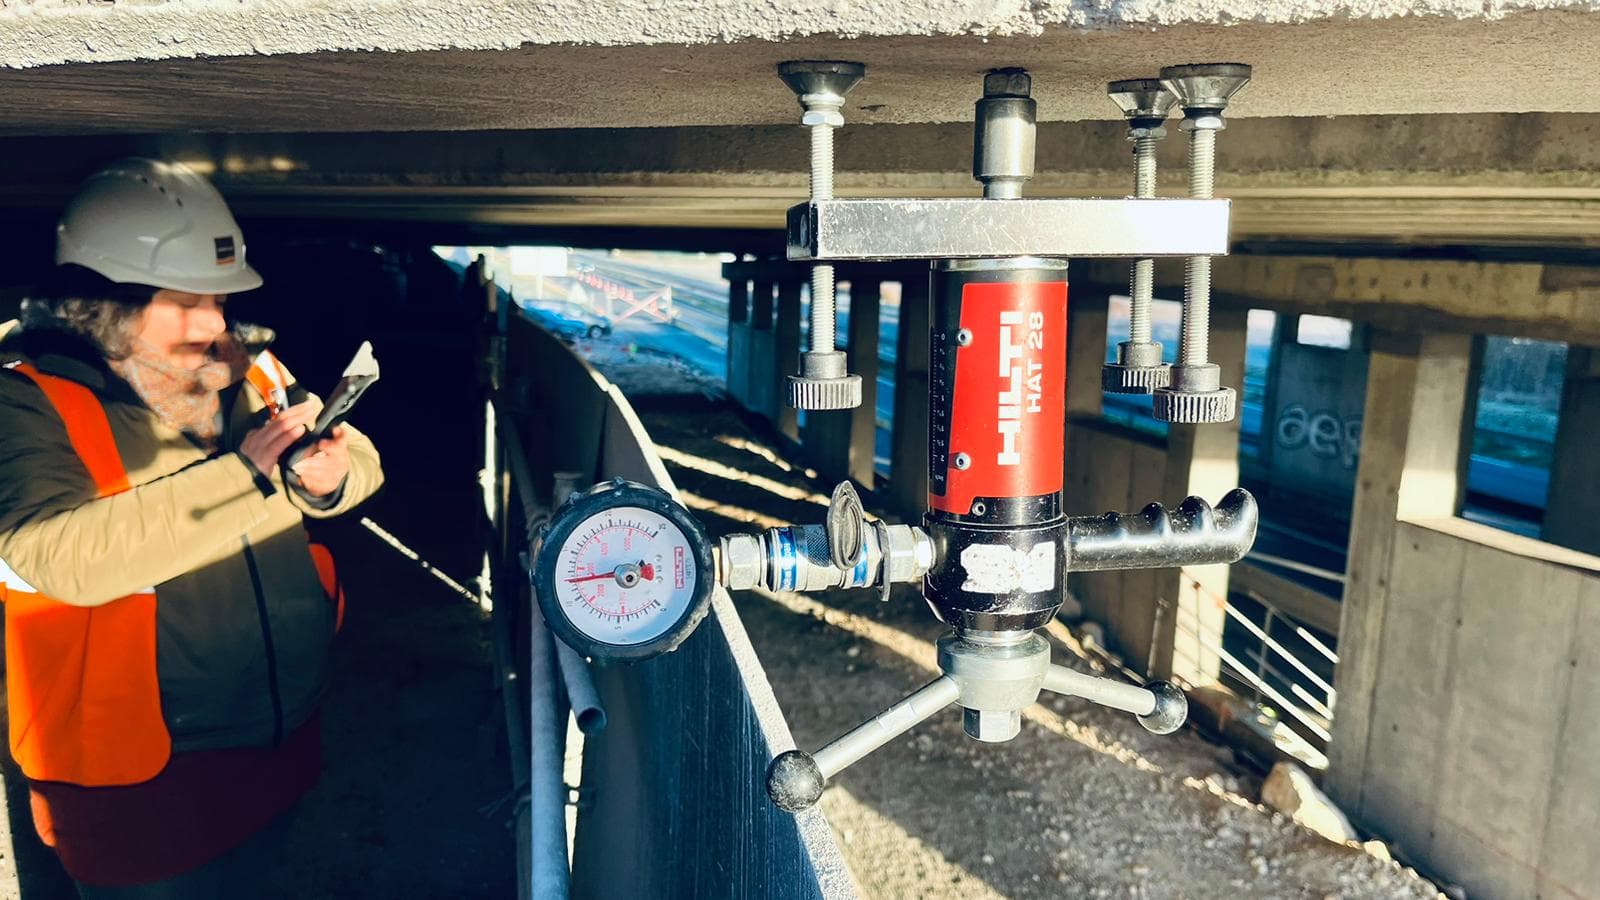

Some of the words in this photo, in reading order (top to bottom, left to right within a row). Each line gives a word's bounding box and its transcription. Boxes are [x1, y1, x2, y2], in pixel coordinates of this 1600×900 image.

[1028, 311, 1044, 350] 28
[997, 311, 1024, 466] HILTI
[1027, 358, 1043, 413] HAT
